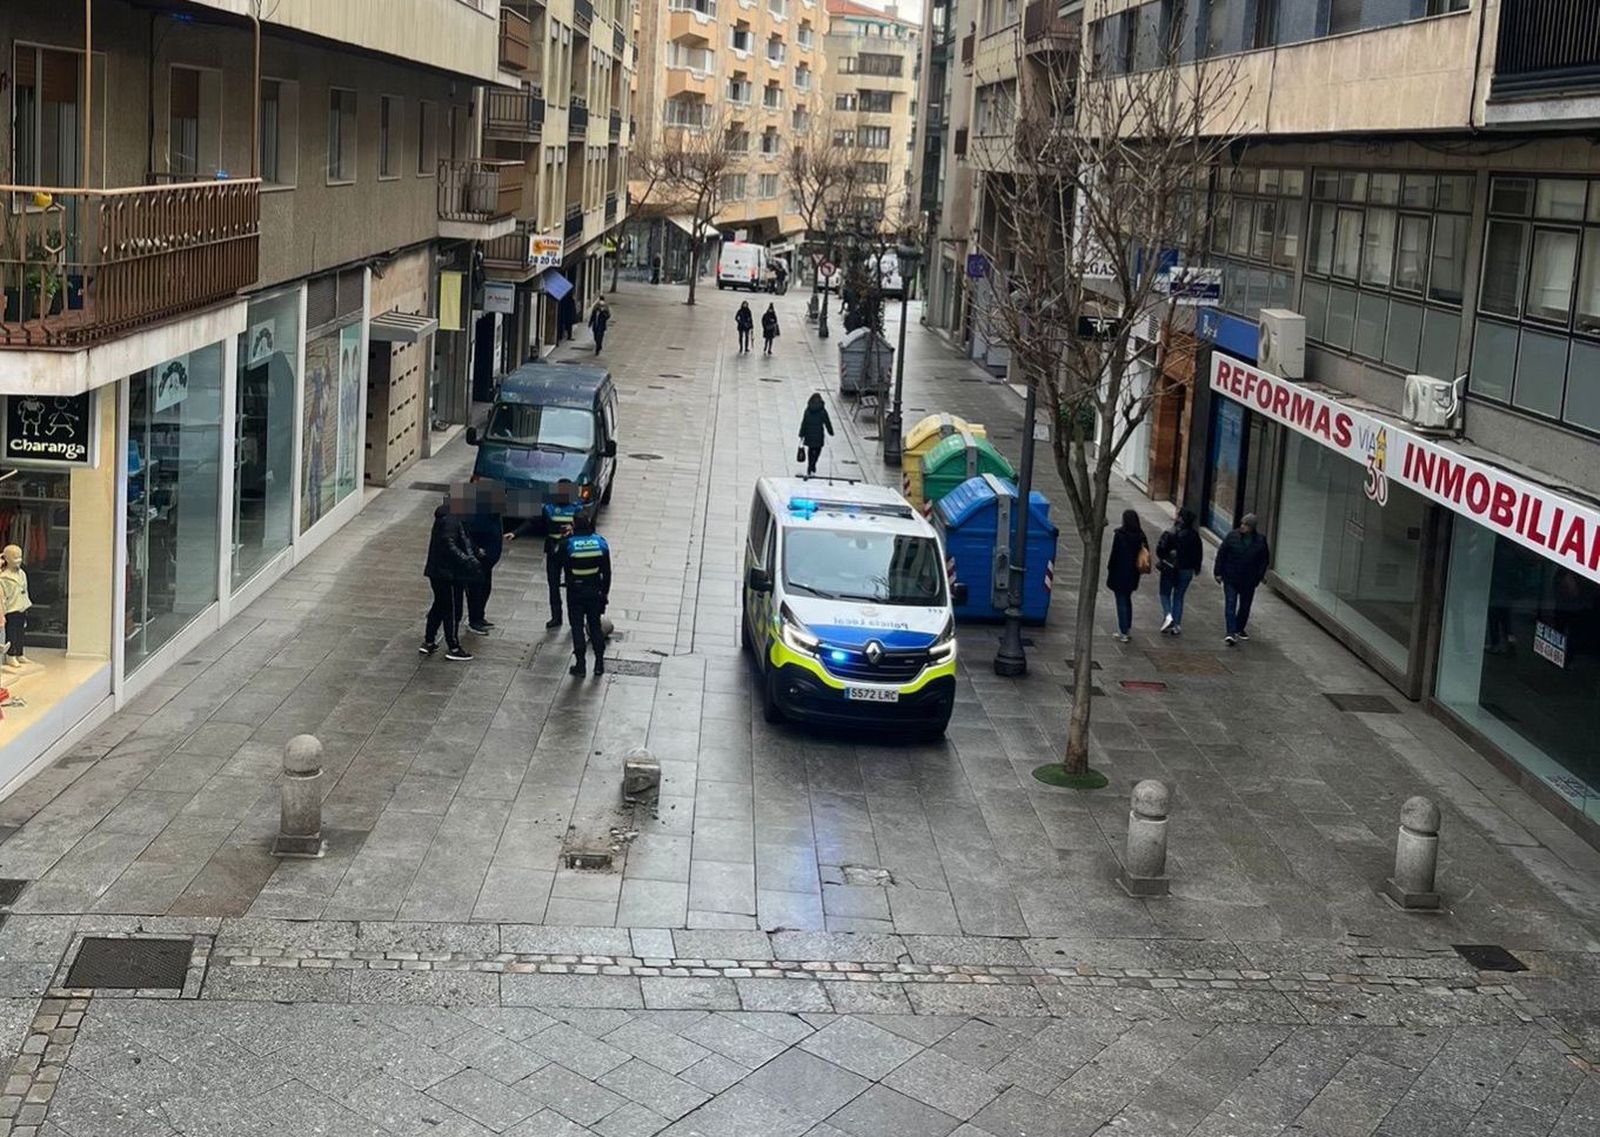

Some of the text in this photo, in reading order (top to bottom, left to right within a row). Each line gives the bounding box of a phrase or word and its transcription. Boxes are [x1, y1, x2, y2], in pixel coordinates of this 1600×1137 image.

[1216, 360, 1353, 448] REFORMAS
[10, 438, 85, 459] Charanga
[1364, 454, 1387, 505] 30
[851, 687, 897, 700] 5572 LRC
